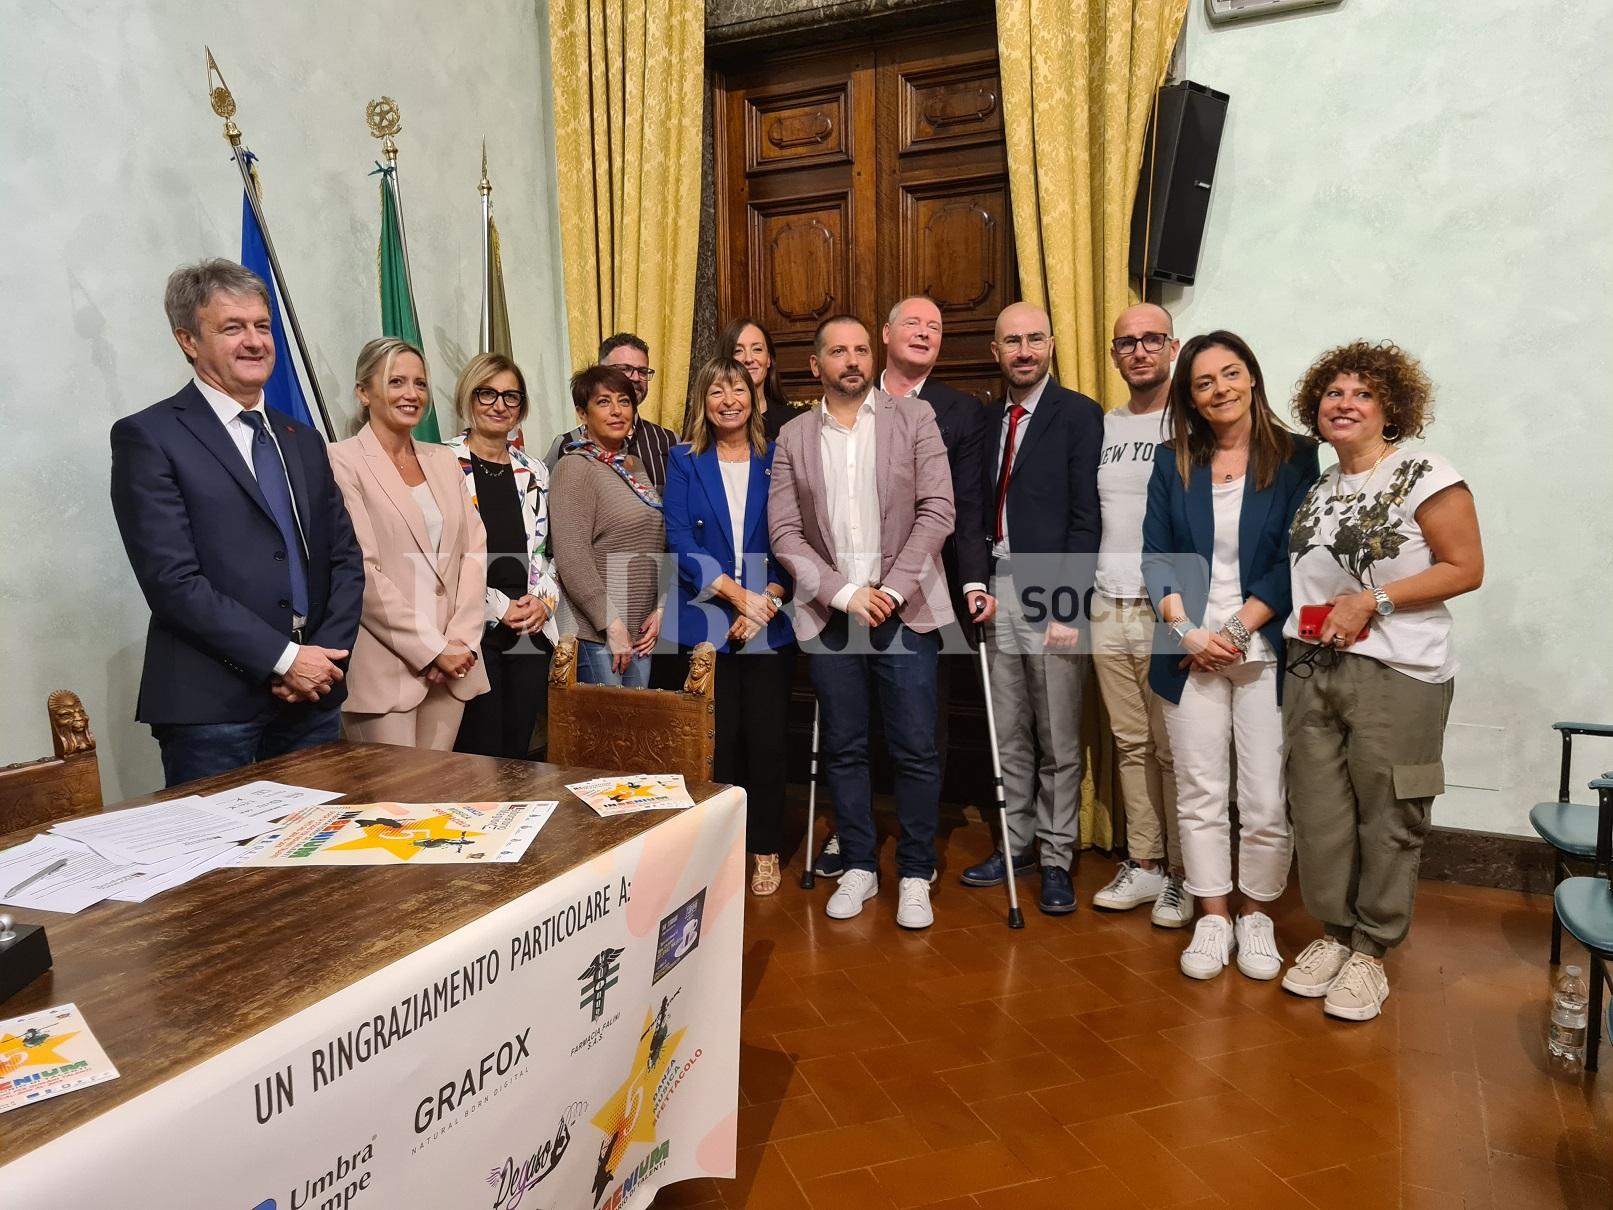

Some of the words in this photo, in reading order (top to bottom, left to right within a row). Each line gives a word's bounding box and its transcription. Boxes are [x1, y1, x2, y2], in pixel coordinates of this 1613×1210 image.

[254, 1064, 294, 1125] UN
[312, 949, 500, 1092] RINGRAZIAMENTO
[510, 884, 611, 972] PARTICOLARE
[618, 875, 631, 907] A:
[570, 1027, 601, 1057] FARMACIA
[411, 1117, 459, 1156] NATURAL
[464, 1095, 489, 1118] BORN
[493, 1066, 529, 1097] DIGITAL
[414, 1026, 531, 1134] GRAFOX
[652, 1048, 703, 1128] SPETTACOLO
[653, 1059, 676, 1102] DANZA
[653, 1065, 681, 1114] MUSICA
[637, 1160, 667, 1188] TALENTI
